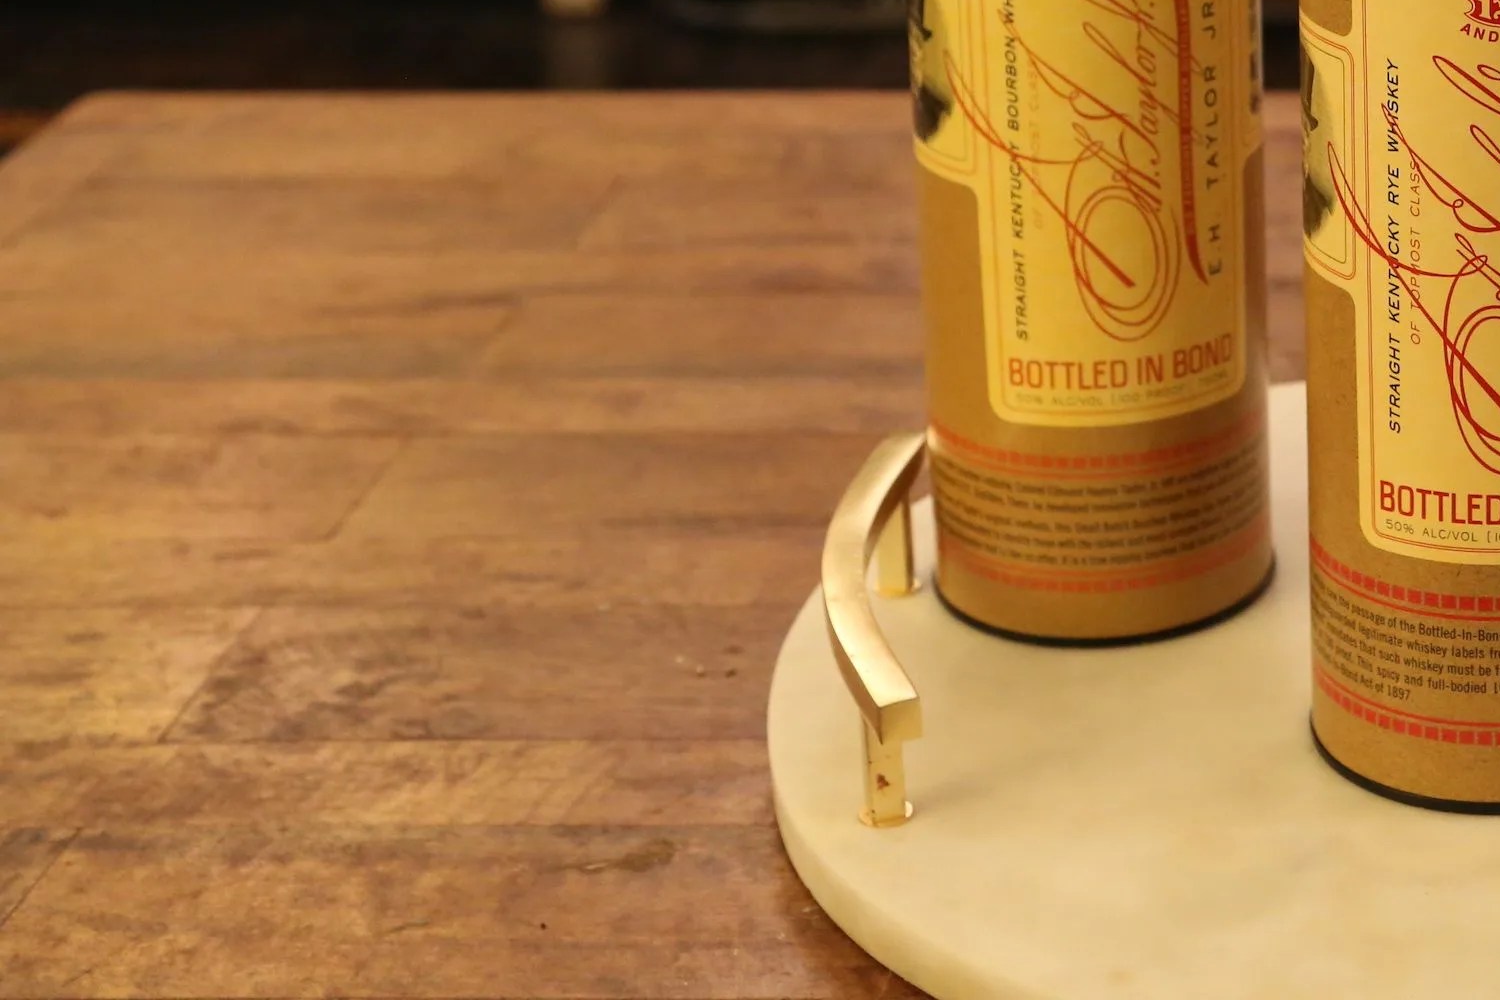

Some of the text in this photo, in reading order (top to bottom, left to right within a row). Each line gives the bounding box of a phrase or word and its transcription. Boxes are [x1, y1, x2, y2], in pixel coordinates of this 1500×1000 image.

[1459, 22, 1499, 43] AND
[1004, 36, 1019, 131] BOURBON
[1386, 57, 1400, 153] WHISKEY
[1204, 65, 1219, 190] TAYLOR
[1009, 141, 1023, 240] KENTUCY
[1387, 164, 1400, 206] RYE
[1410, 160, 1421, 218] CLASS
[1012, 248, 1029, 342] STRAIGHT
[1410, 320, 1421, 346] OF
[1008, 356, 1129, 391] BOTTLED
[1136, 353, 1165, 386] IN
[1171, 333, 1233, 380] BOND
[1389, 332, 1401, 434] STRAIGHT
[1385, 517, 1415, 535] 50%
[1421, 527, 1479, 543] ALC/VOL
[1351, 603, 1386, 627] passage
[1387, 616, 1398, 629] of
[1400, 620, 1416, 633] the
[1358, 621, 1404, 648] legitimate
[1406, 640, 1448, 658] whiskey
[1451, 646, 1485, 659] labels
[1403, 657, 1444, 675] whiskey
[1447, 665, 1475, 676] must
[1478, 665, 1492, 677] be
[1403, 674, 1424, 688] and
[1427, 677, 1488, 694] full-bodied
